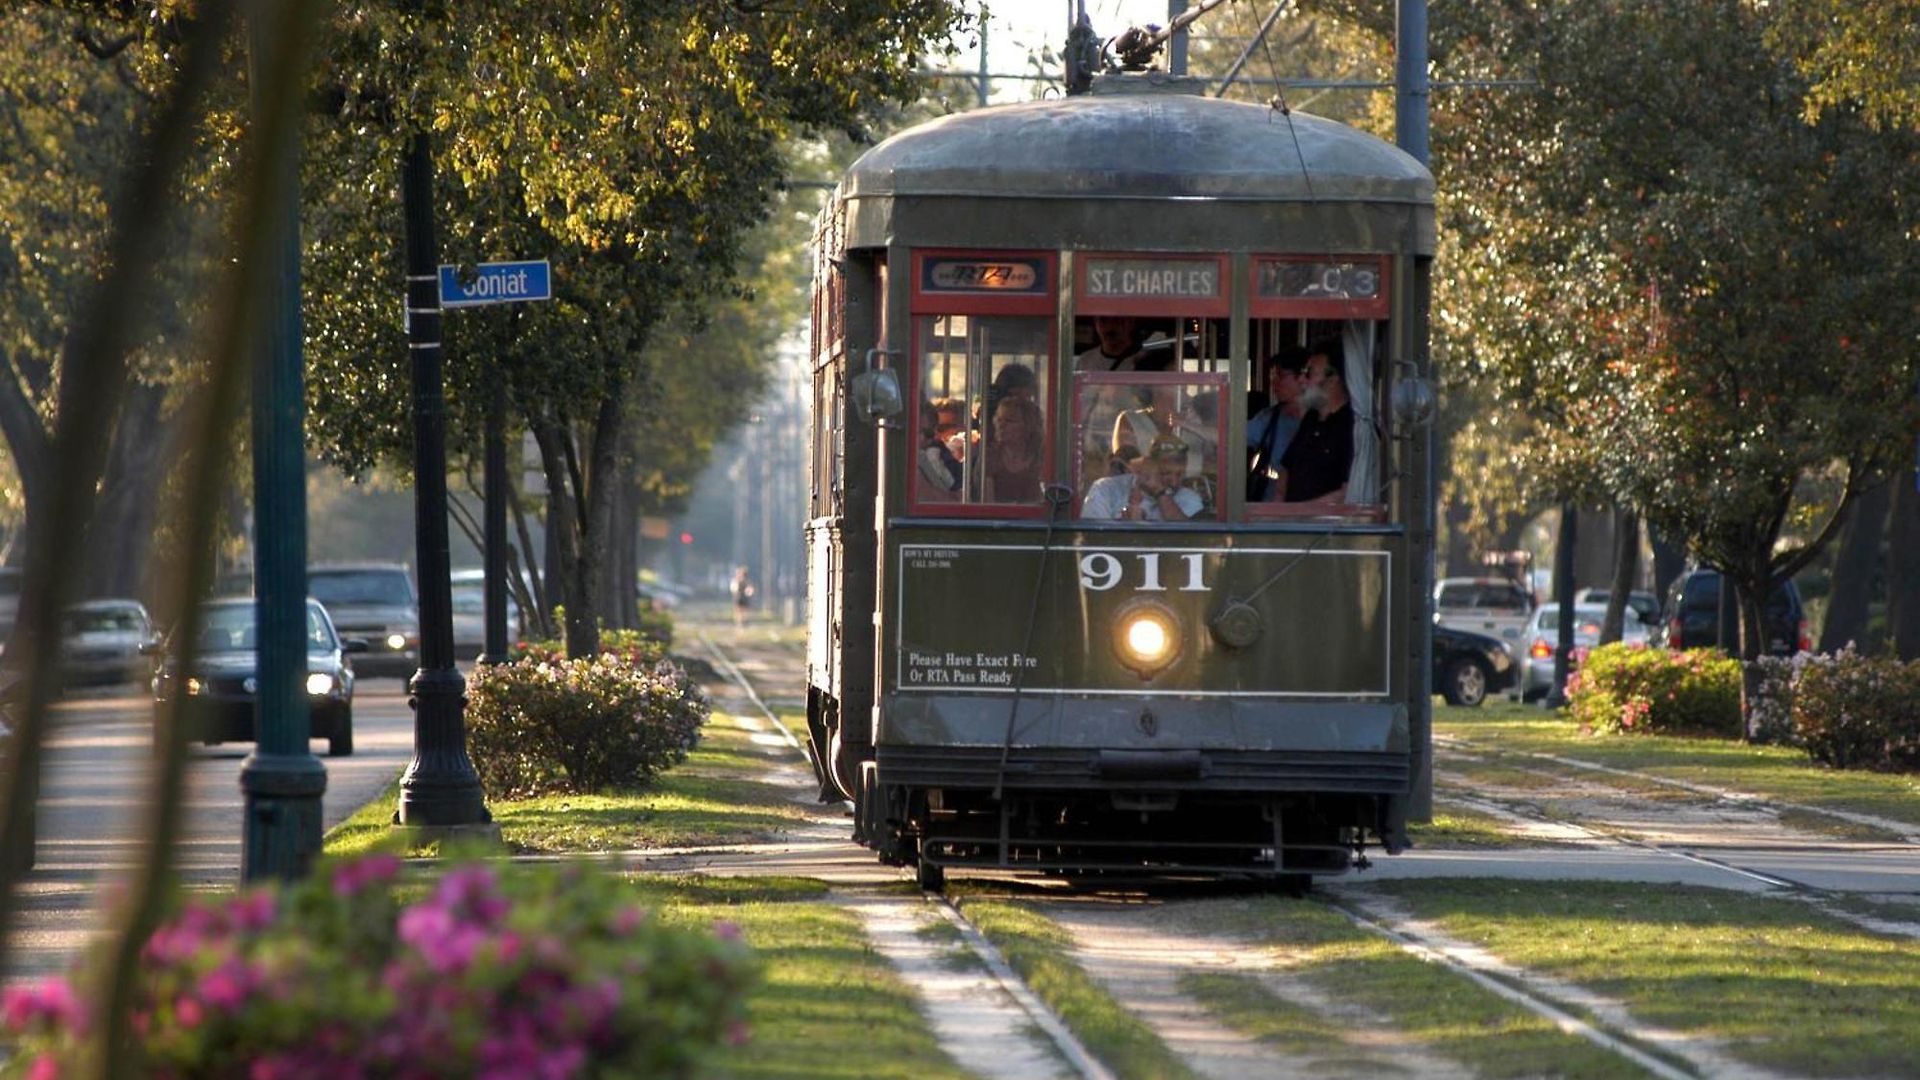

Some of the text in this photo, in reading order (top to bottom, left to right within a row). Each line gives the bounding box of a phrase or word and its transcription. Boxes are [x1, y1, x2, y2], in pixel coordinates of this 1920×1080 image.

[1091, 269, 1213, 296] ST. CHARLES
[1079, 552, 1213, 592] 911
[909, 652, 1038, 668] Please Have Exact Fre
[909, 668, 1013, 686] Or RTA Pass Ready
